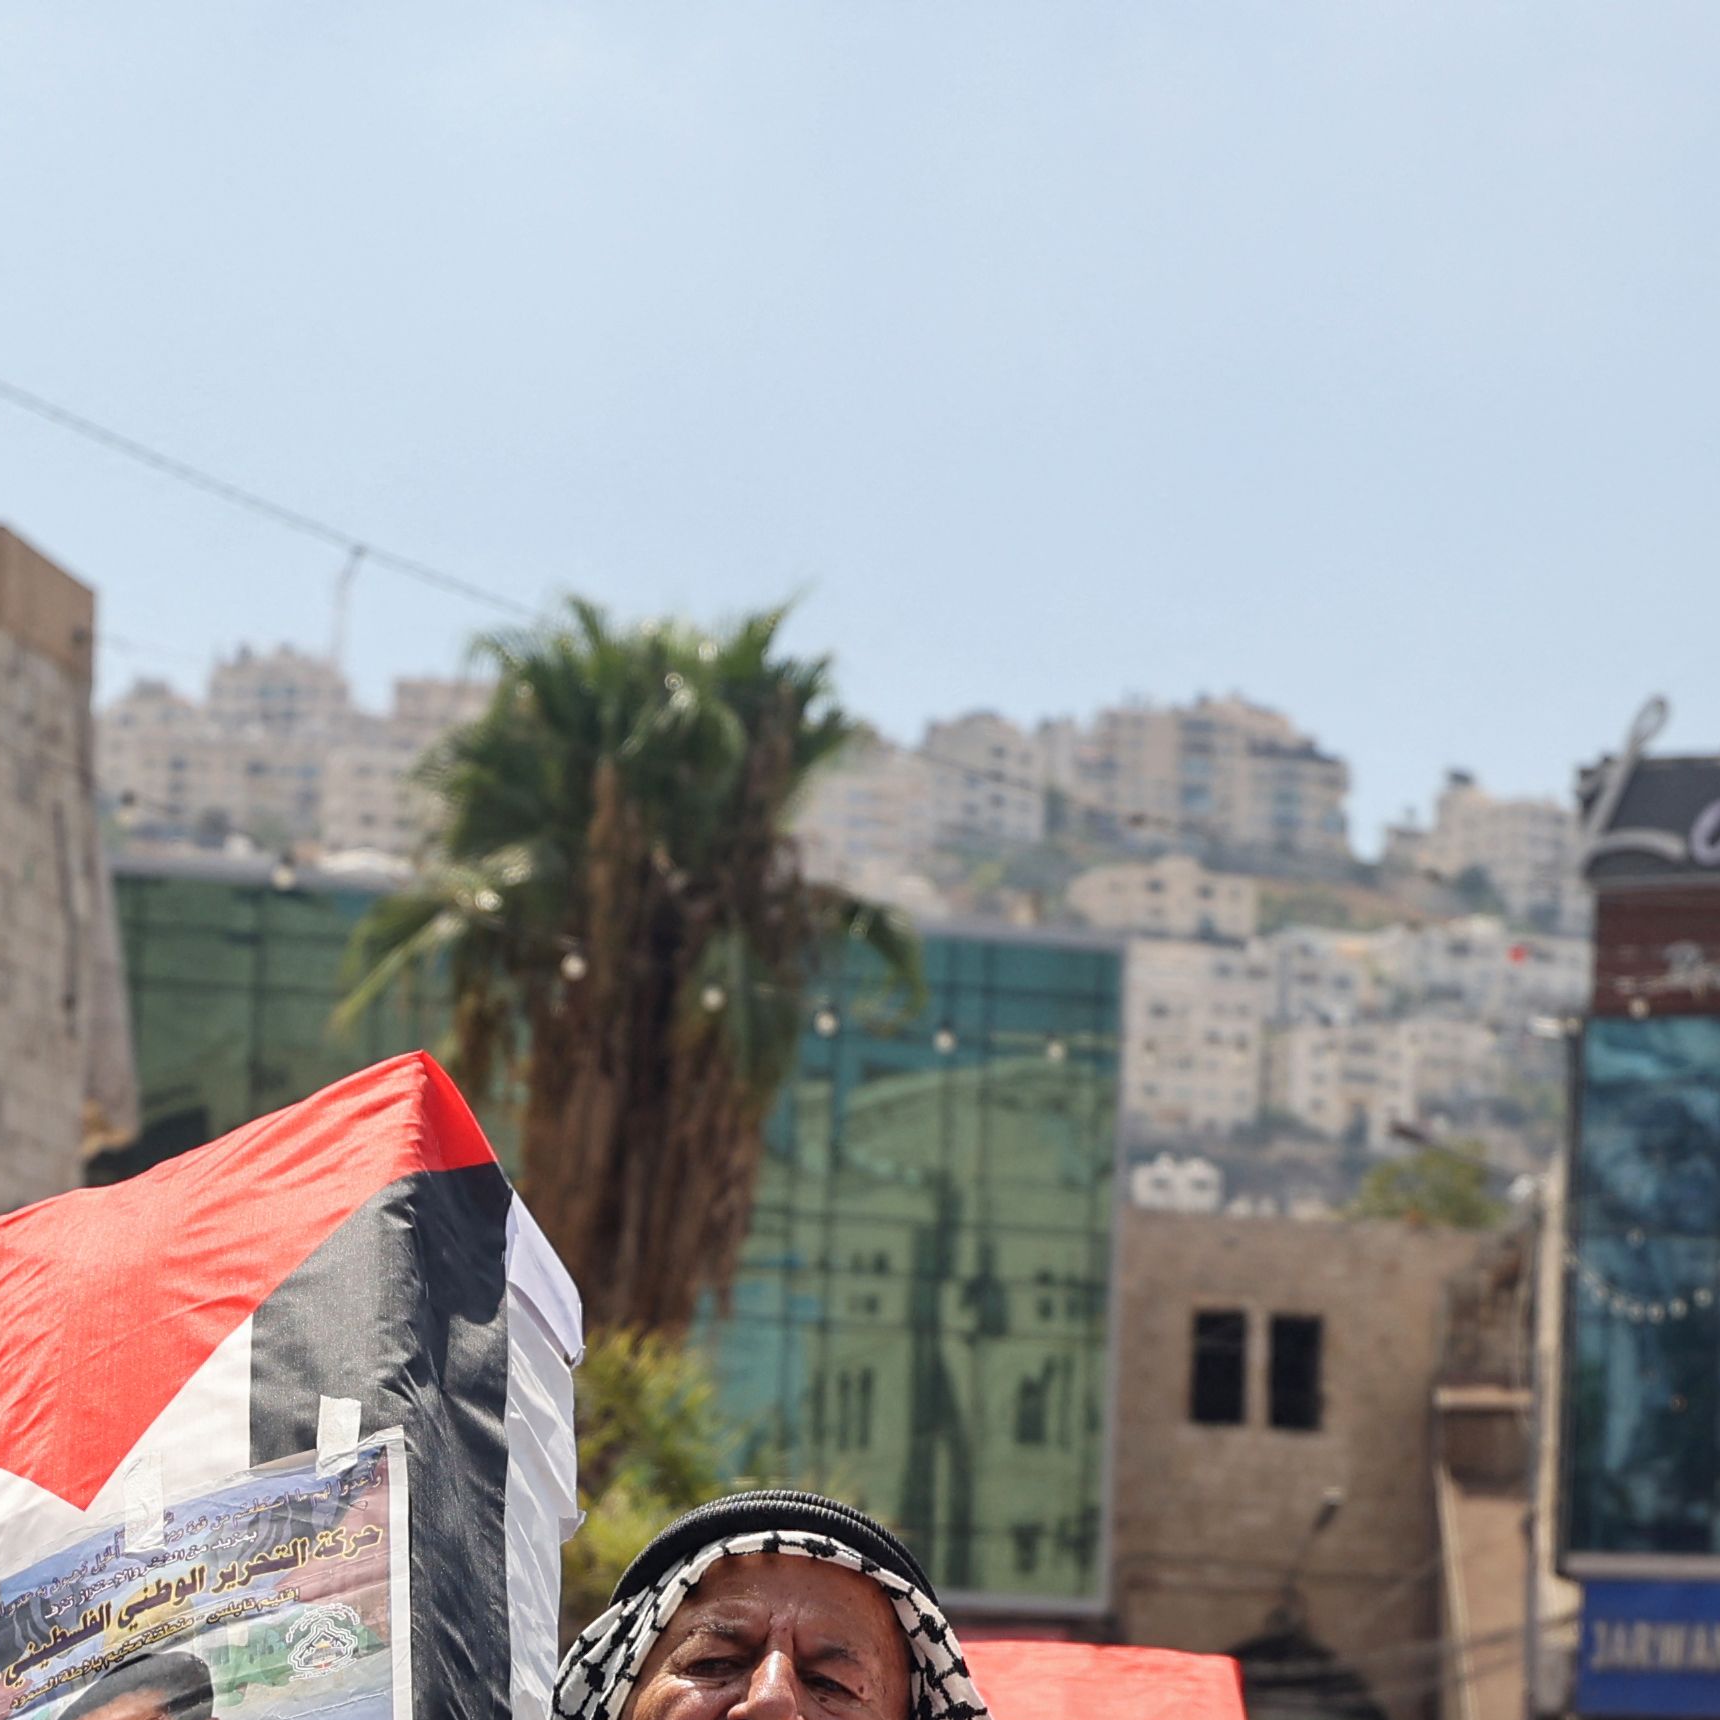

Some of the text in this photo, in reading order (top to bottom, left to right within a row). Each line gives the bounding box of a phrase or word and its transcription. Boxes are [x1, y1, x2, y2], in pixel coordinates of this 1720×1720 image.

[184, 1543, 210, 1561] من
[212, 1530, 258, 1550] بمزيد
[312, 1524, 383, 1560] حركة
[210, 1537, 309, 1595] التحرير
[116, 1563, 207, 1632] الوطني
[206, 1596, 260, 1625] نابلس
[4, 1600, 112, 1689] الفلسطيني
[103, 1637, 143, 1666] مخيم
[11, 1669, 62, 1709] الصمود
